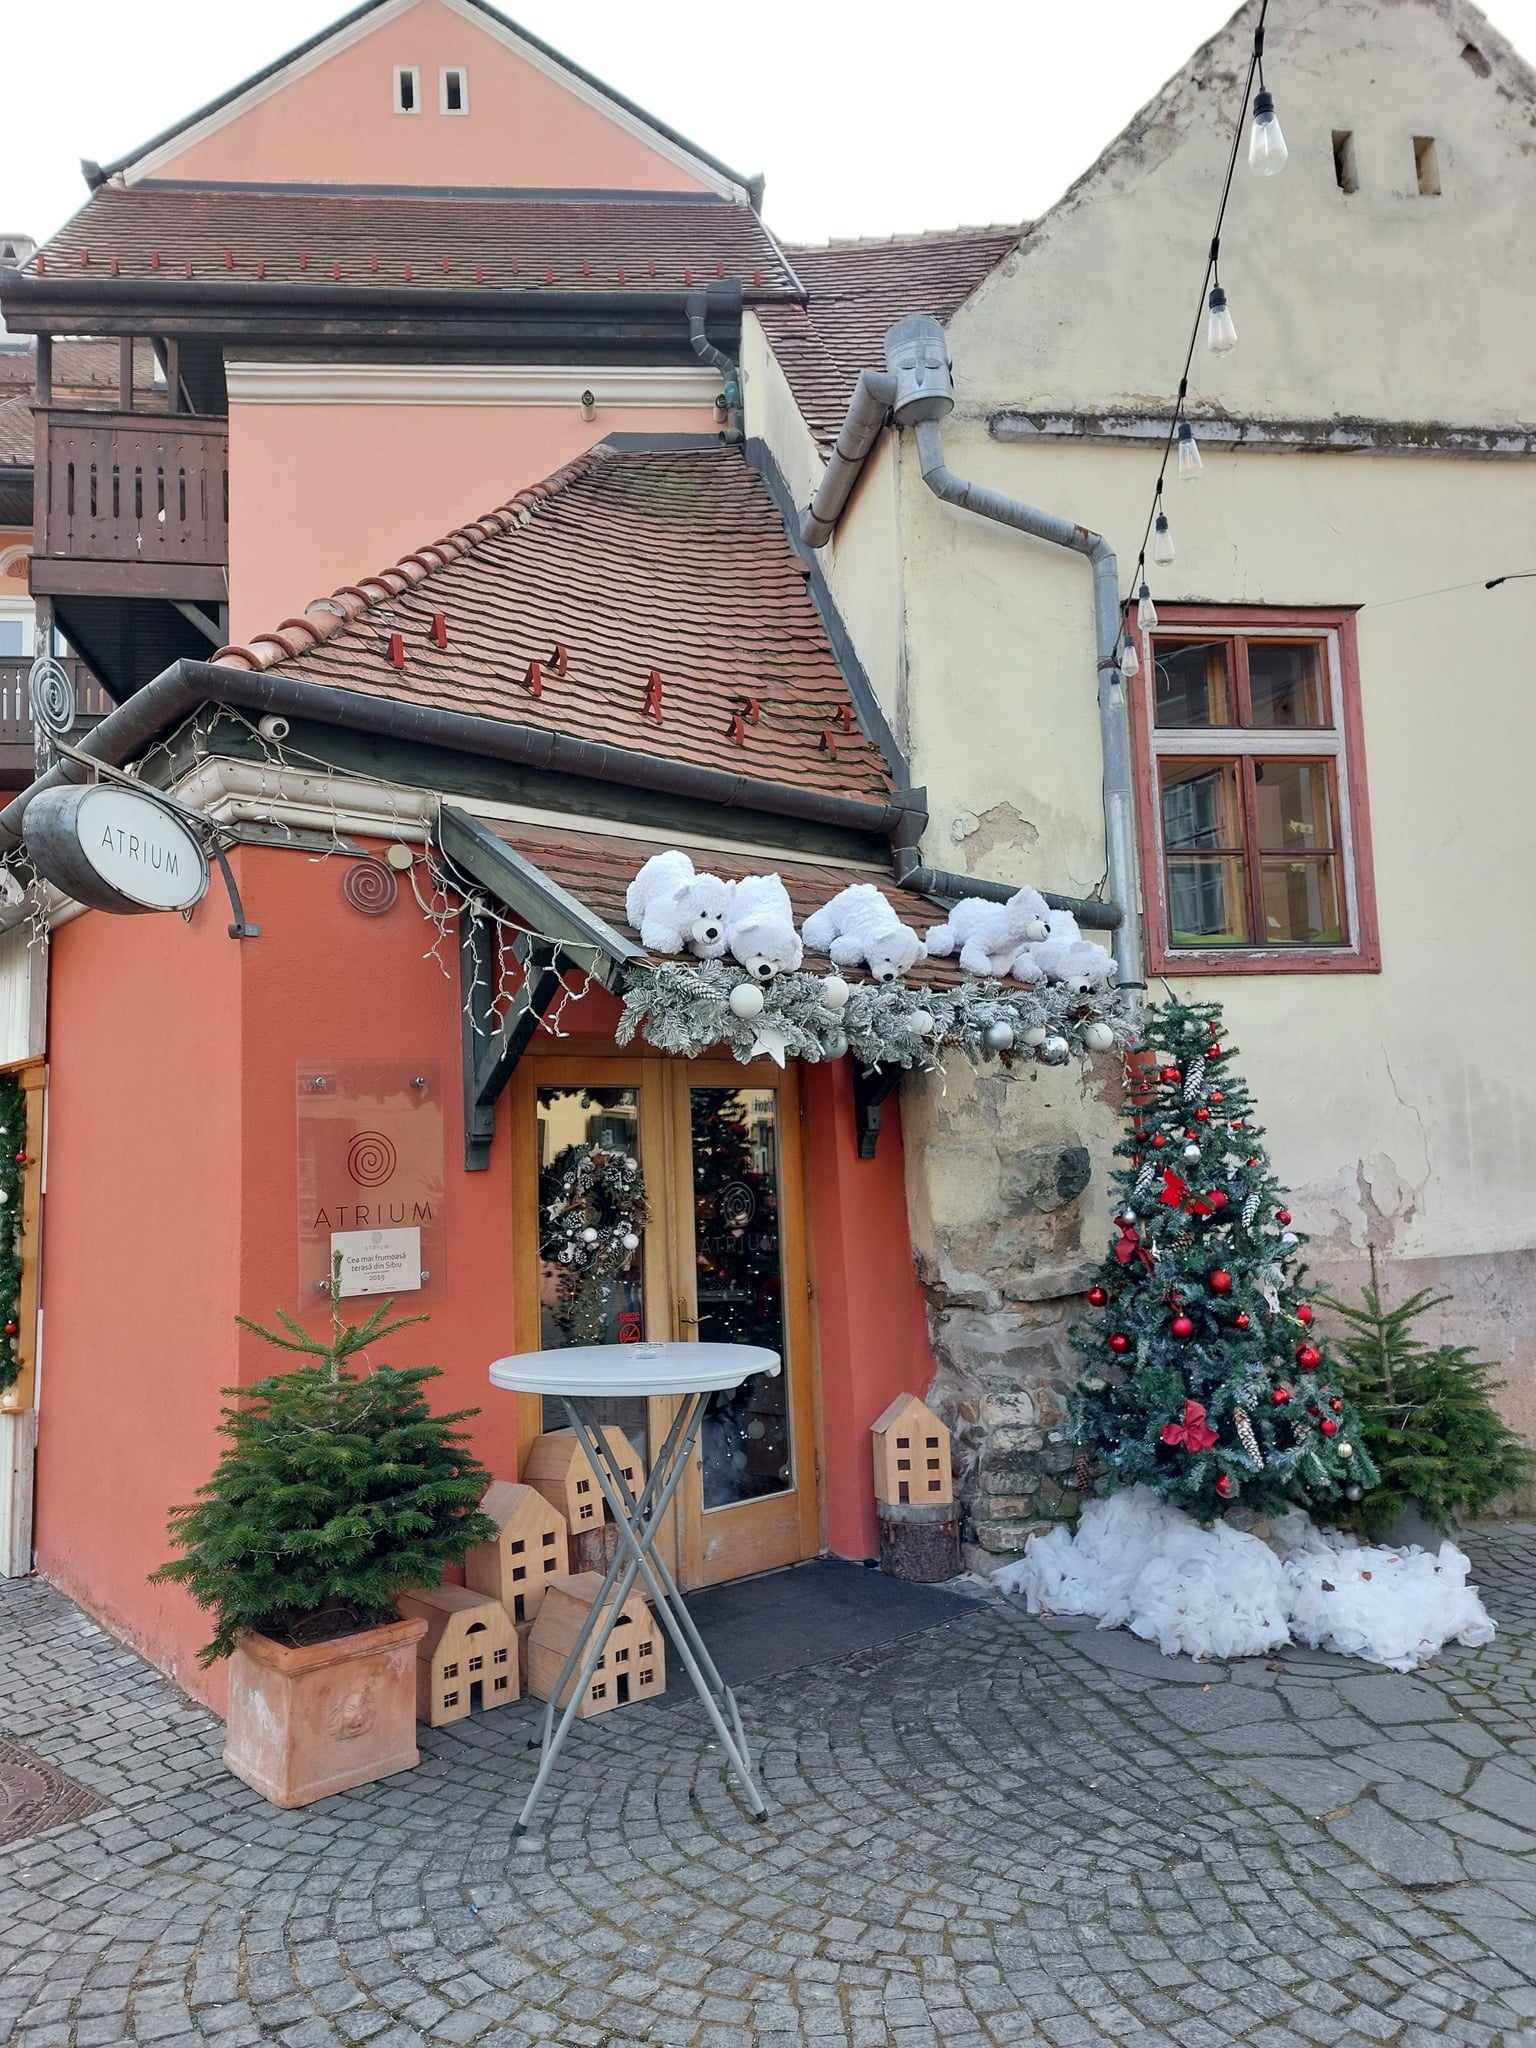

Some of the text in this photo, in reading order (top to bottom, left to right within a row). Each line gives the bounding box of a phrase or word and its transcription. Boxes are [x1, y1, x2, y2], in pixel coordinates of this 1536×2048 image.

[101, 824, 179, 877] ATRIUM
[313, 1201, 432, 1229] ATRIUM
[346, 1252, 406, 1264] Cea mai frumoasă
[351, 1264, 373, 1272] terasă
[373, 1262, 385, 1270] din
[369, 1274, 385, 1282] 2019
